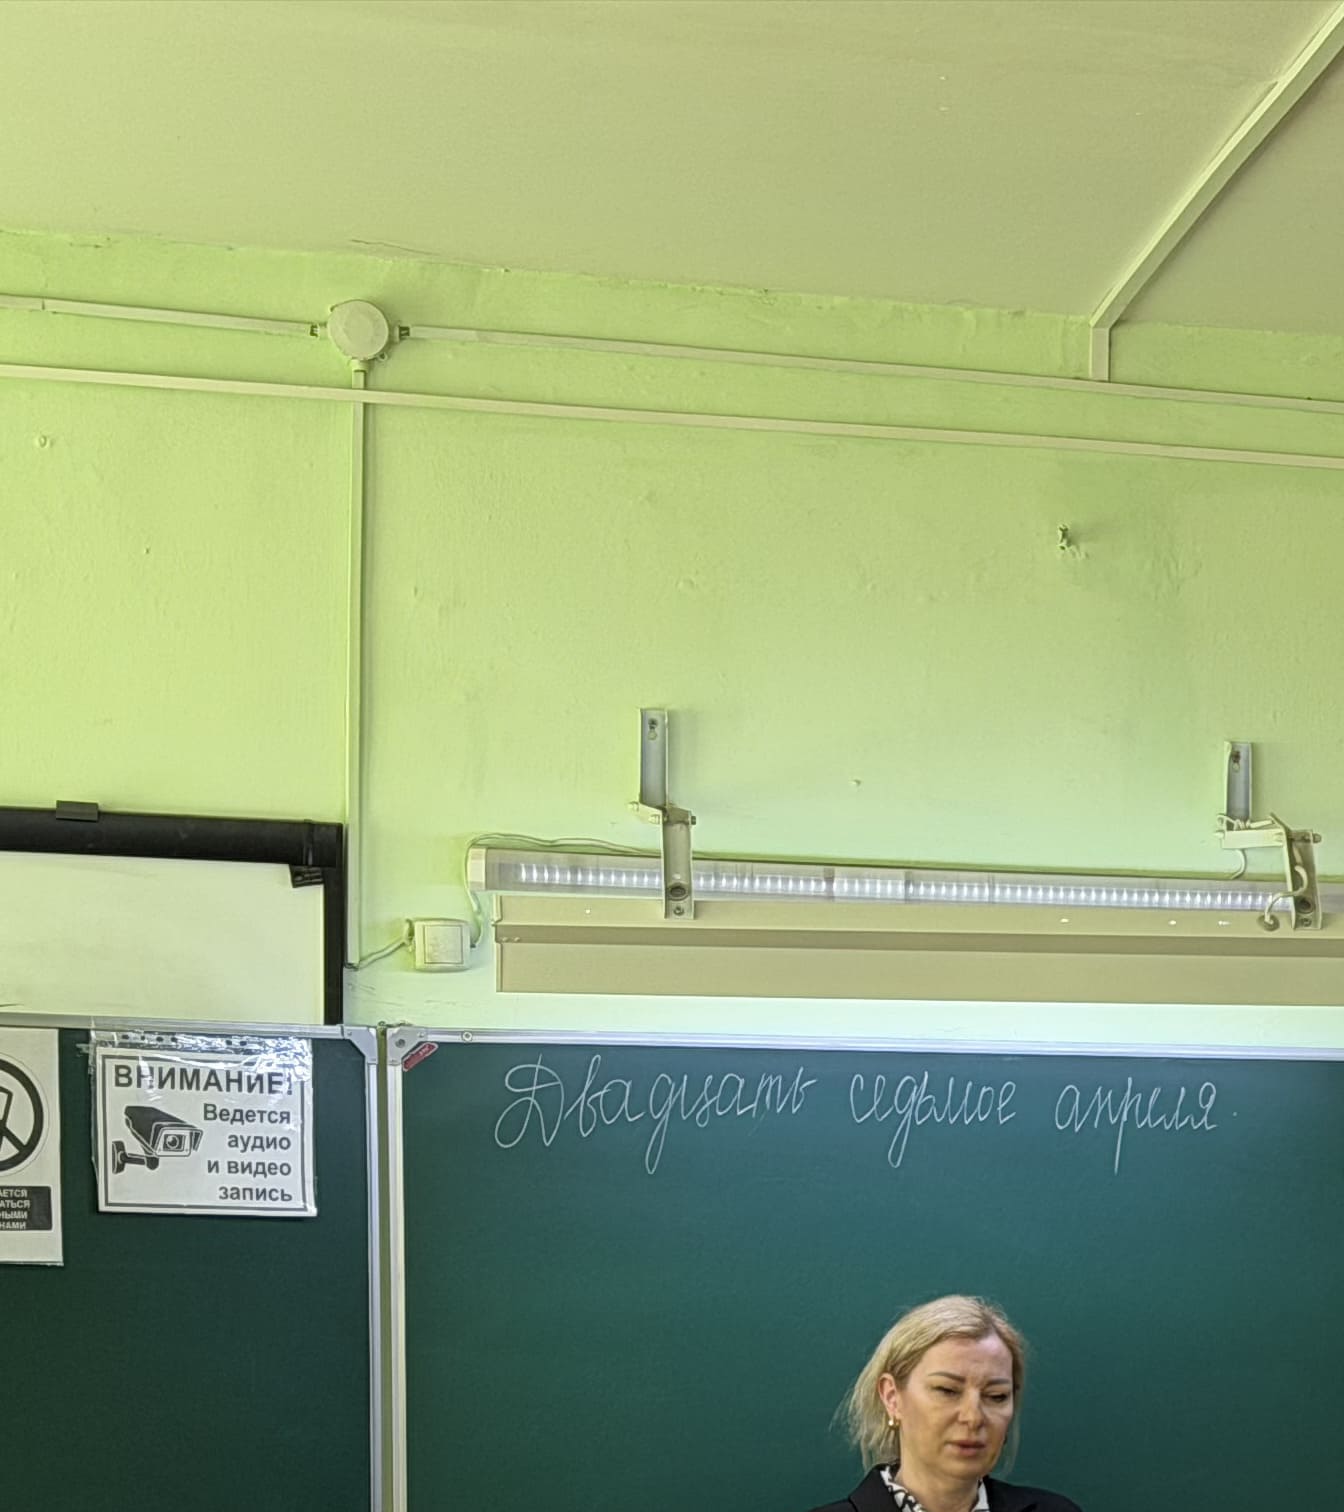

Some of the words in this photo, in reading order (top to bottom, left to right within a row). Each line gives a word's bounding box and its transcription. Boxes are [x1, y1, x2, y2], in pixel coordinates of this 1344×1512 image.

[114, 1064, 293, 1096] ВНИМАНИЕ!
[203, 1103, 291, 1125] Ведется
[494, 1053, 819, 1175] Двадцать
[849, 1070, 1017, 1168] седьмое
[227, 1134, 292, 1153] аудио
[207, 1160, 219, 1174] и
[228, 1160, 292, 1178] видео
[218, 1186, 293, 1202] запись
